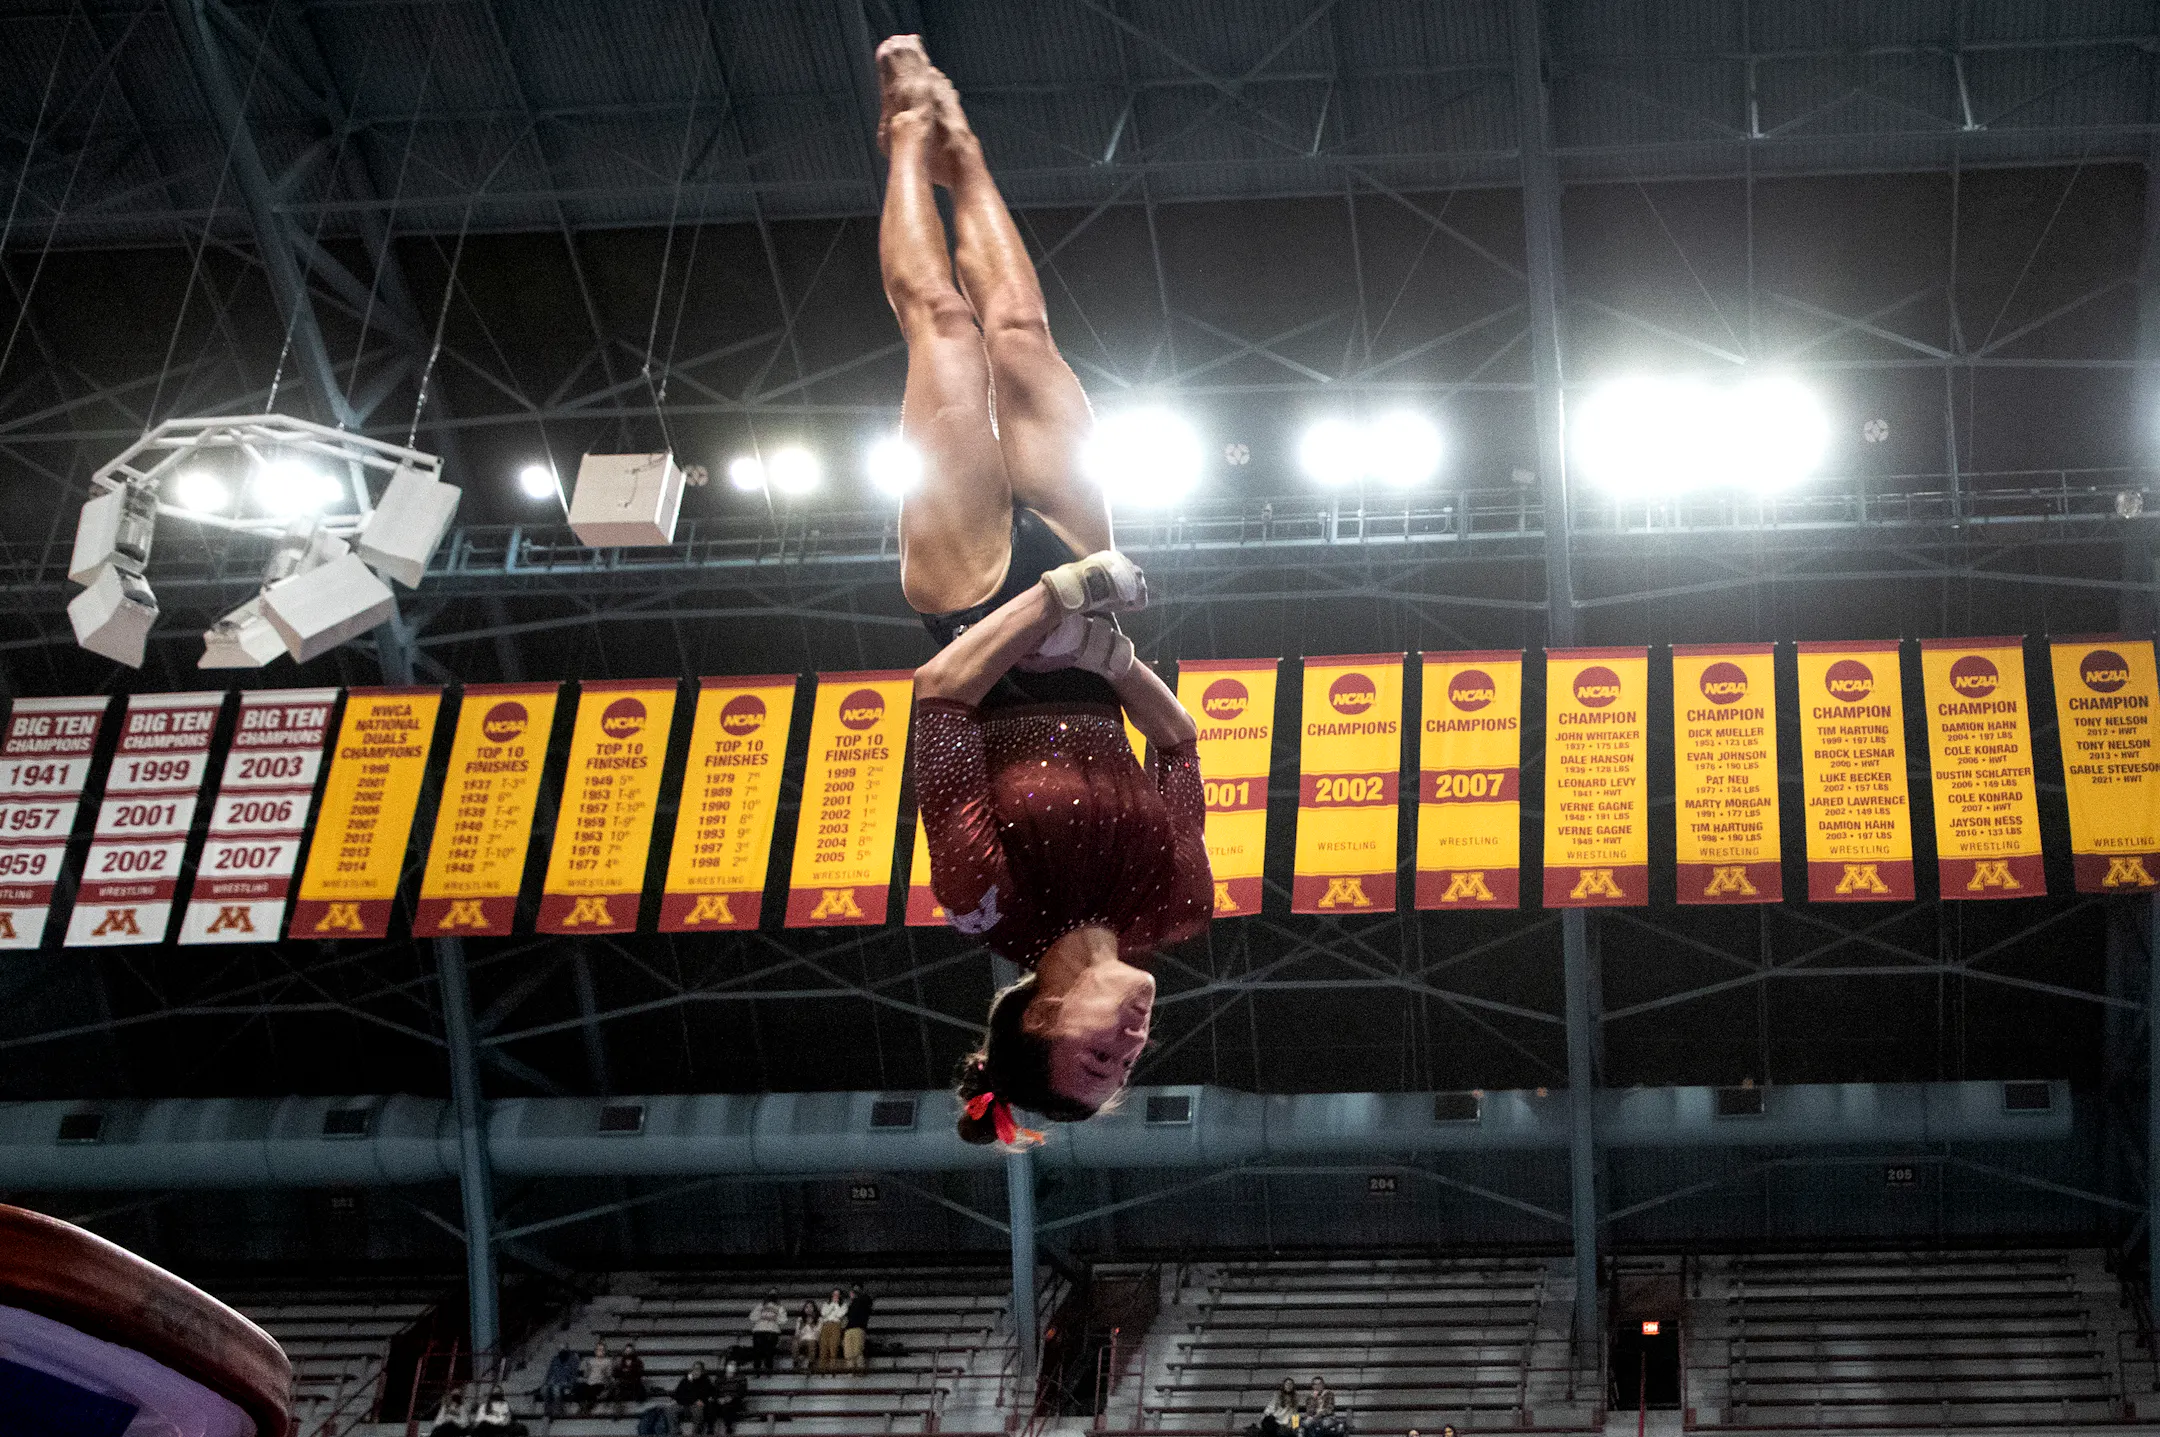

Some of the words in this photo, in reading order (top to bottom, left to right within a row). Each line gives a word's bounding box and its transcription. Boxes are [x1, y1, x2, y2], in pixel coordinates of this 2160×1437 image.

[1956, 675, 1998, 689] NCAA
[2086, 669, 2128, 683] NCAA
[1578, 686, 1620, 699] NCAA
[1704, 682, 1746, 695] NCAA
[1830, 679, 1872, 693] NCAA
[1333, 692, 1376, 706] NCAA
[1452, 689, 1494, 703] NCAA
[1206, 697, 1248, 711] NCAA
[1938, 700, 2017, 716] CHAMPION
[2069, 695, 2149, 711] CHAMPION
[371, 705, 412, 716] NWCA
[843, 707, 884, 721] NCAA
[1687, 707, 1765, 722] CHAMPION
[1813, 705, 1891, 720] CHAMPION
[129, 713, 167, 733] BIG
[171, 711, 213, 732] TEN
[243, 709, 281, 729] BIG
[285, 707, 327, 727] TEN
[1426, 716, 1517, 733] CHAMPIONS
[1558, 711, 1637, 726] CHAMPION
[2074, 717, 2101, 727] TONY
[2106, 715, 2148, 726] NELSON
[12, 716, 51, 736] BIG
[54, 715, 97, 735] TEN
[355, 719, 420, 731] NATIONAL
[1307, 720, 1397, 737] CHAMPIONS
[1817, 726, 1836, 736] TIM
[1840, 724, 1889, 735] HARTUNG
[1942, 721, 1984, 733] DAMION
[1988, 720, 2017, 731] HAHN
[2087, 728, 2108, 736] 2012
[2119, 727, 2137, 735] HWT
[236, 729, 323, 746] CHAMPIONS
[362, 732, 408, 744] DUALS
[1197, 726, 1268, 741] AMPIONS
[1555, 731, 1583, 741] JOHN
[1586, 731, 1640, 741] WHITAKER
[1688, 728, 1713, 739] DICK
[1716, 727, 1764, 738] MUELLER
[5, 737, 92, 752] CHAMPIONS
[122, 732, 209, 750] CHAMPIONS
[715, 740, 741, 753] TOP
[748, 739, 763, 752] 10
[835, 734, 861, 748] TOP
[867, 733, 883, 746] 10
[1614, 741, 1630, 750] LBS
[2077, 740, 2104, 751] TONY
[2109, 739, 2151, 750] NELSON
[341, 745, 422, 759] CHAMPIONS
[477, 746, 502, 759] TOP
[508, 746, 524, 758] 10
[596, 742, 622, 755] TOP
[627, 742, 643, 754] 10
[825, 748, 889, 762] FINISHES
[1814, 748, 1850, 759] BROCK
[1853, 748, 1895, 758] LESNAR
[1944, 745, 1971, 757] COLE
[1975, 743, 2018, 755] KONRAD
[704, 753, 768, 767] FINISHES
[1561, 755, 1588, 765] DALE
[1591, 753, 1635, 764] HANSON
[1687, 752, 1714, 762] EVAN
[1718, 750, 1767, 761] JOHNSON
[2089, 752, 2111, 761] 2013
[2121, 750, 2140, 759] HWT
[239, 756, 303, 779] 2003
[465, 760, 528, 773] FINISHES
[586, 756, 647, 769] FINISHES
[1744, 761, 1759, 770] LBS
[2069, 764, 2104, 775] GABLE
[2108, 762, 2160, 774] STEVESON
[11, 764, 70, 786] 1941
[128, 760, 190, 783] 1999
[827, 767, 856, 778] 1999
[1820, 772, 1846, 783] LUKE
[1850, 772, 1892, 782] BECKER
[1936, 770, 1972, 780] DUSTIN
[1976, 766, 2031, 779] SCHLATTER
[1436, 773, 1505, 799] 2007
[1558, 778, 1607, 789] LEONARD
[1611, 777, 1636, 787] LEVY
[1706, 775, 1724, 785] PAT
[1728, 775, 1749, 784] NEU
[2092, 775, 2113, 784] 2021
[824, 781, 854, 793] 2000
[1315, 776, 1384, 802] 2002
[1873, 783, 1889, 791] LBS
[822, 795, 851, 806] 2001
[1204, 782, 1249, 808] 001
[1809, 796, 1844, 807] JARED
[1847, 795, 1906, 807] LAWRENCE
[1948, 793, 1975, 804] COLE
[1979, 791, 2023, 802] KONRAD
[1560, 802, 1594, 812] VERNE
[1598, 800, 1634, 811] GAGNE
[1685, 798, 1721, 809] MARTY
[1725, 797, 1771, 808] MORGAN
[113, 804, 176, 827] 2001
[227, 801, 292, 824] 2006
[820, 809, 851, 820] 2002
[0, 809, 60, 831] 1957
[1691, 823, 1710, 832] TIM
[1713, 821, 1763, 832] HARTUNG
[1818, 820, 1861, 831] DAMION
[1865, 820, 1895, 830] HAHN
[1949, 817, 1991, 828] JAYSON
[1995, 815, 2023, 826] NESS
[818, 823, 849, 835] 2003
[1558, 825, 1593, 836] VERNE
[1597, 824, 1632, 835] GAGNE
[2006, 826, 2022, 836] LBS
[816, 837, 847, 849] 2004
[1317, 841, 1377, 851] WRESTLING
[1439, 836, 1499, 847] WRESTLING
[1960, 840, 2020, 852] WRESTLING
[2094, 837, 2155, 848] WRESTLING
[1567, 850, 1627, 860] WRESTLING
[1700, 846, 1759, 857] WRESTLING
[1829, 844, 1890, 855] WRESTLING
[101, 850, 167, 873] 2002
[215, 847, 282, 869] 2007
[814, 851, 845, 863] 2005
[0, 854, 47, 876] 959
